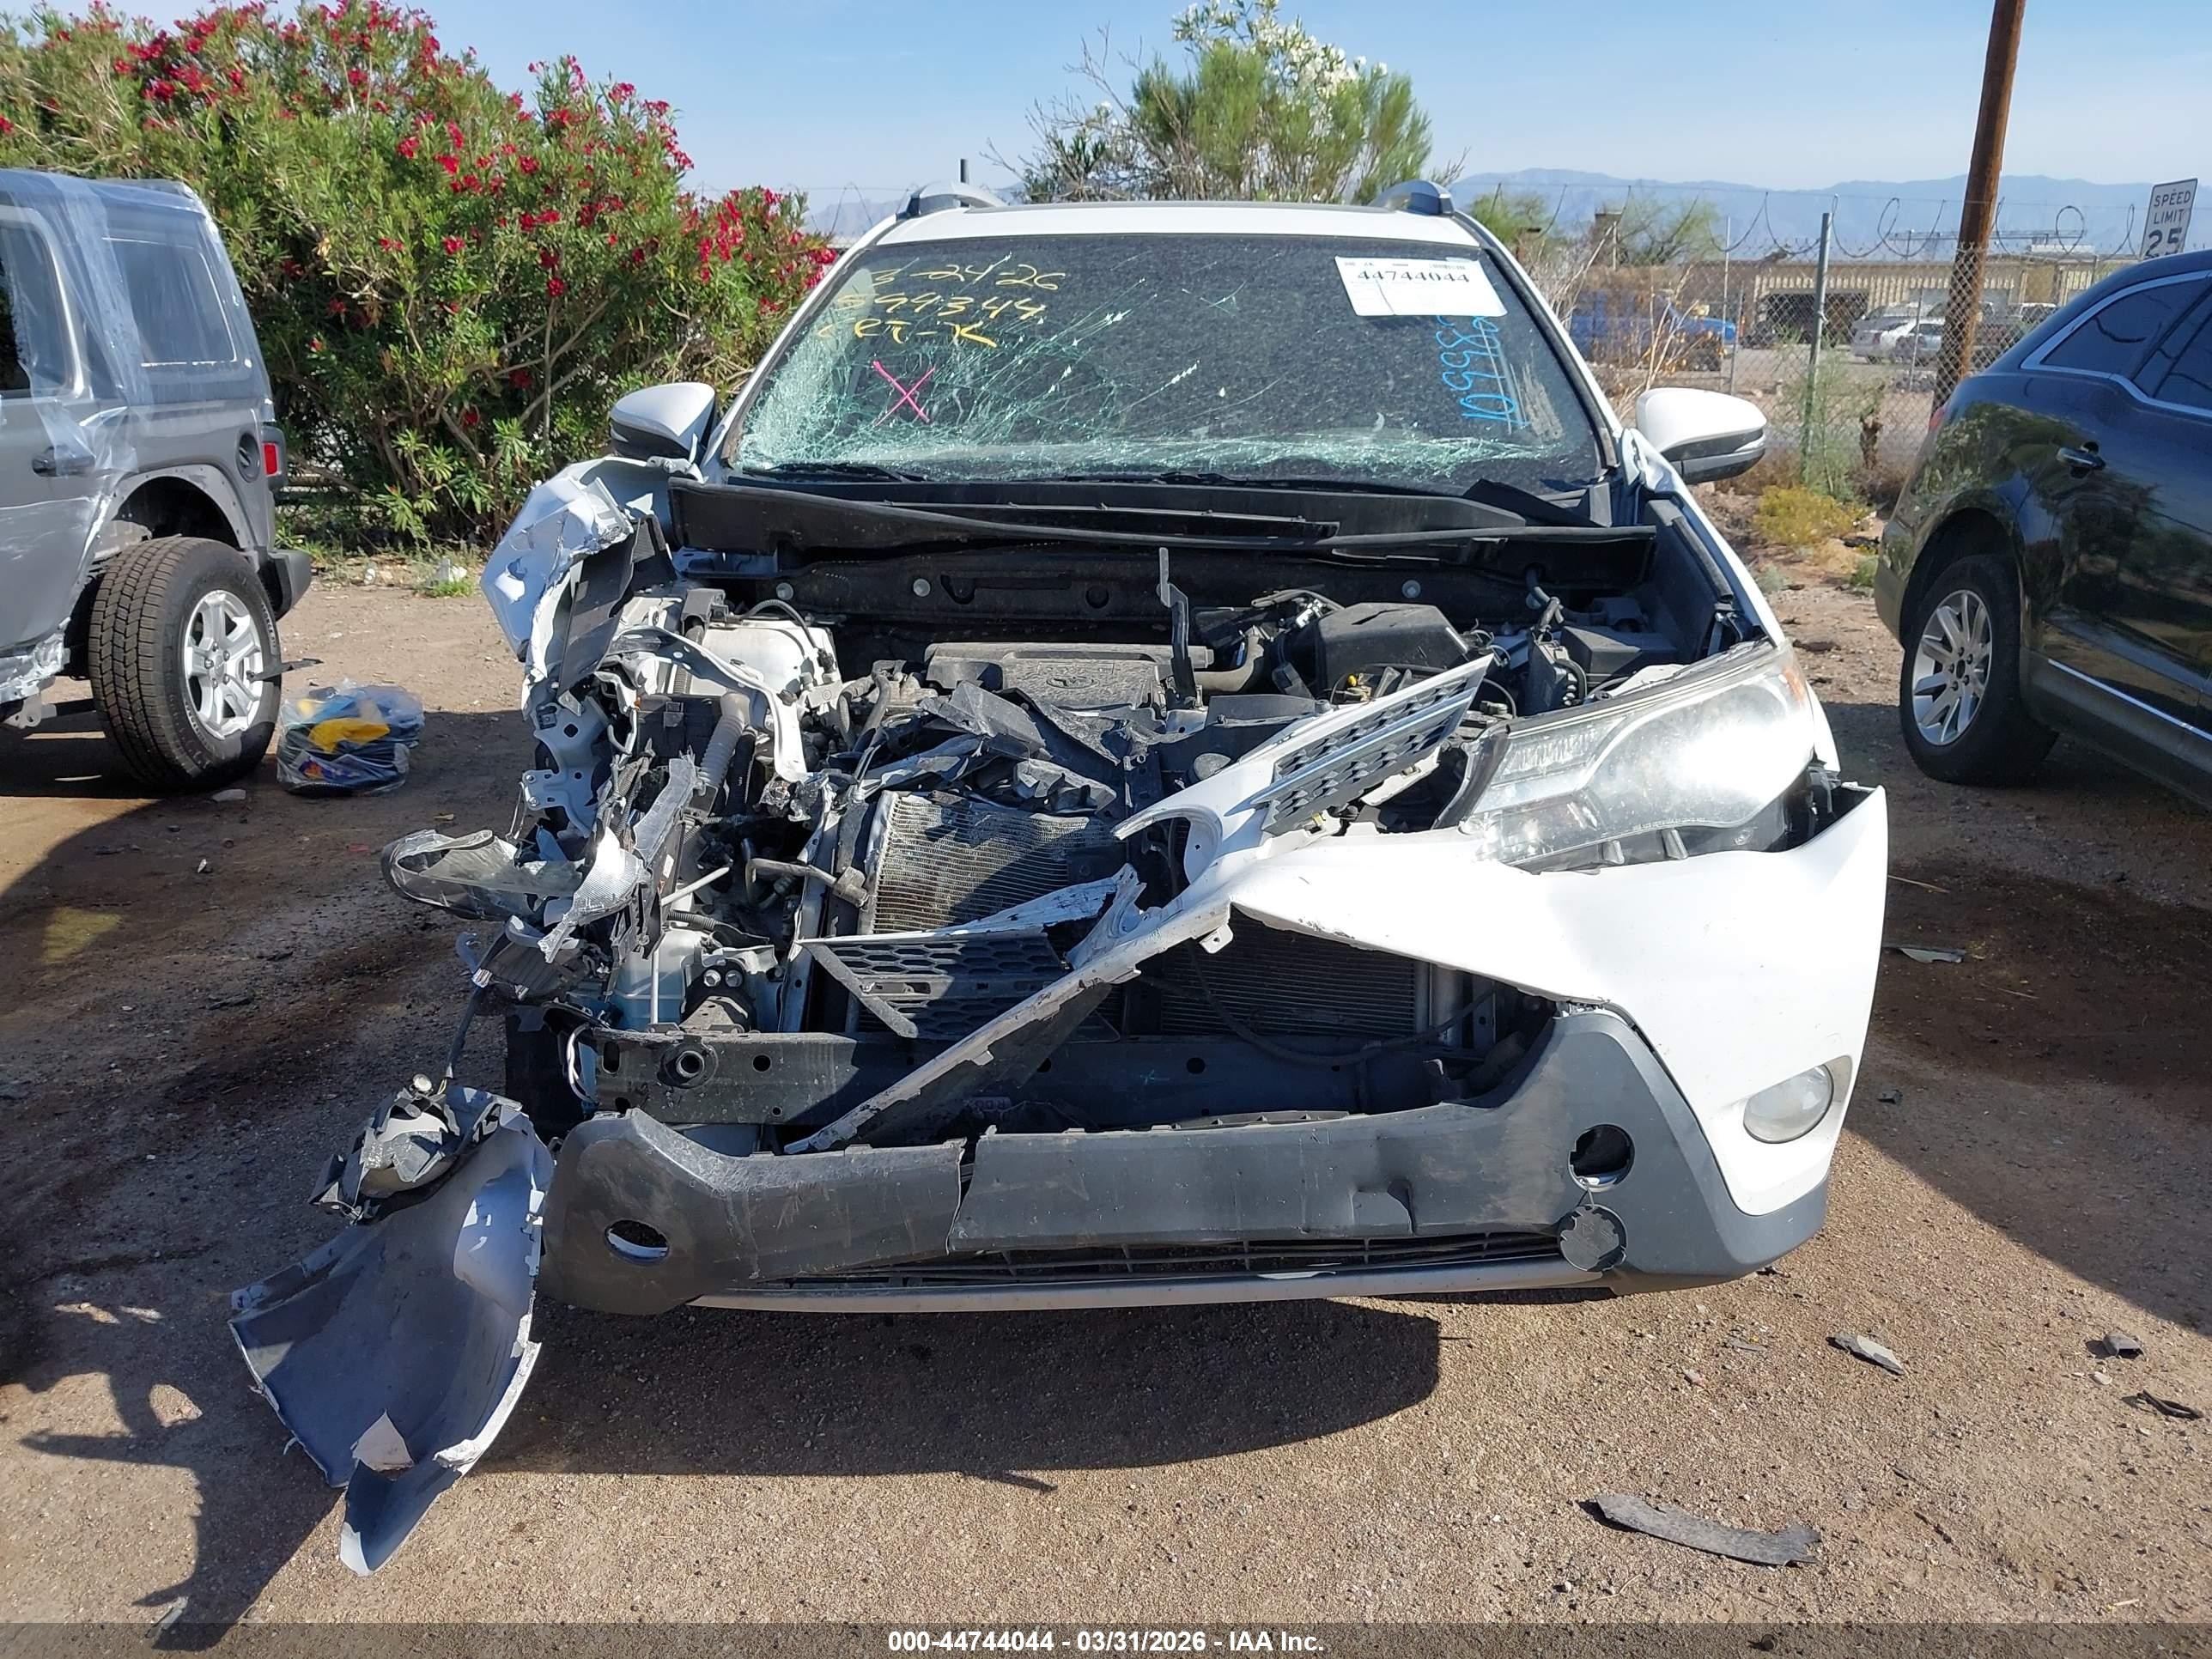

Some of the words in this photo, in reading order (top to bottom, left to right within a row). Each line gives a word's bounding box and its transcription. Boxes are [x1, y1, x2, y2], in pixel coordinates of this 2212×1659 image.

[2153, 190, 2191, 207] SPEED
[2153, 209, 2185, 225] LIMIT
[2143, 227, 2183, 259] 25
[1357, 270, 1470, 283] 44744044
